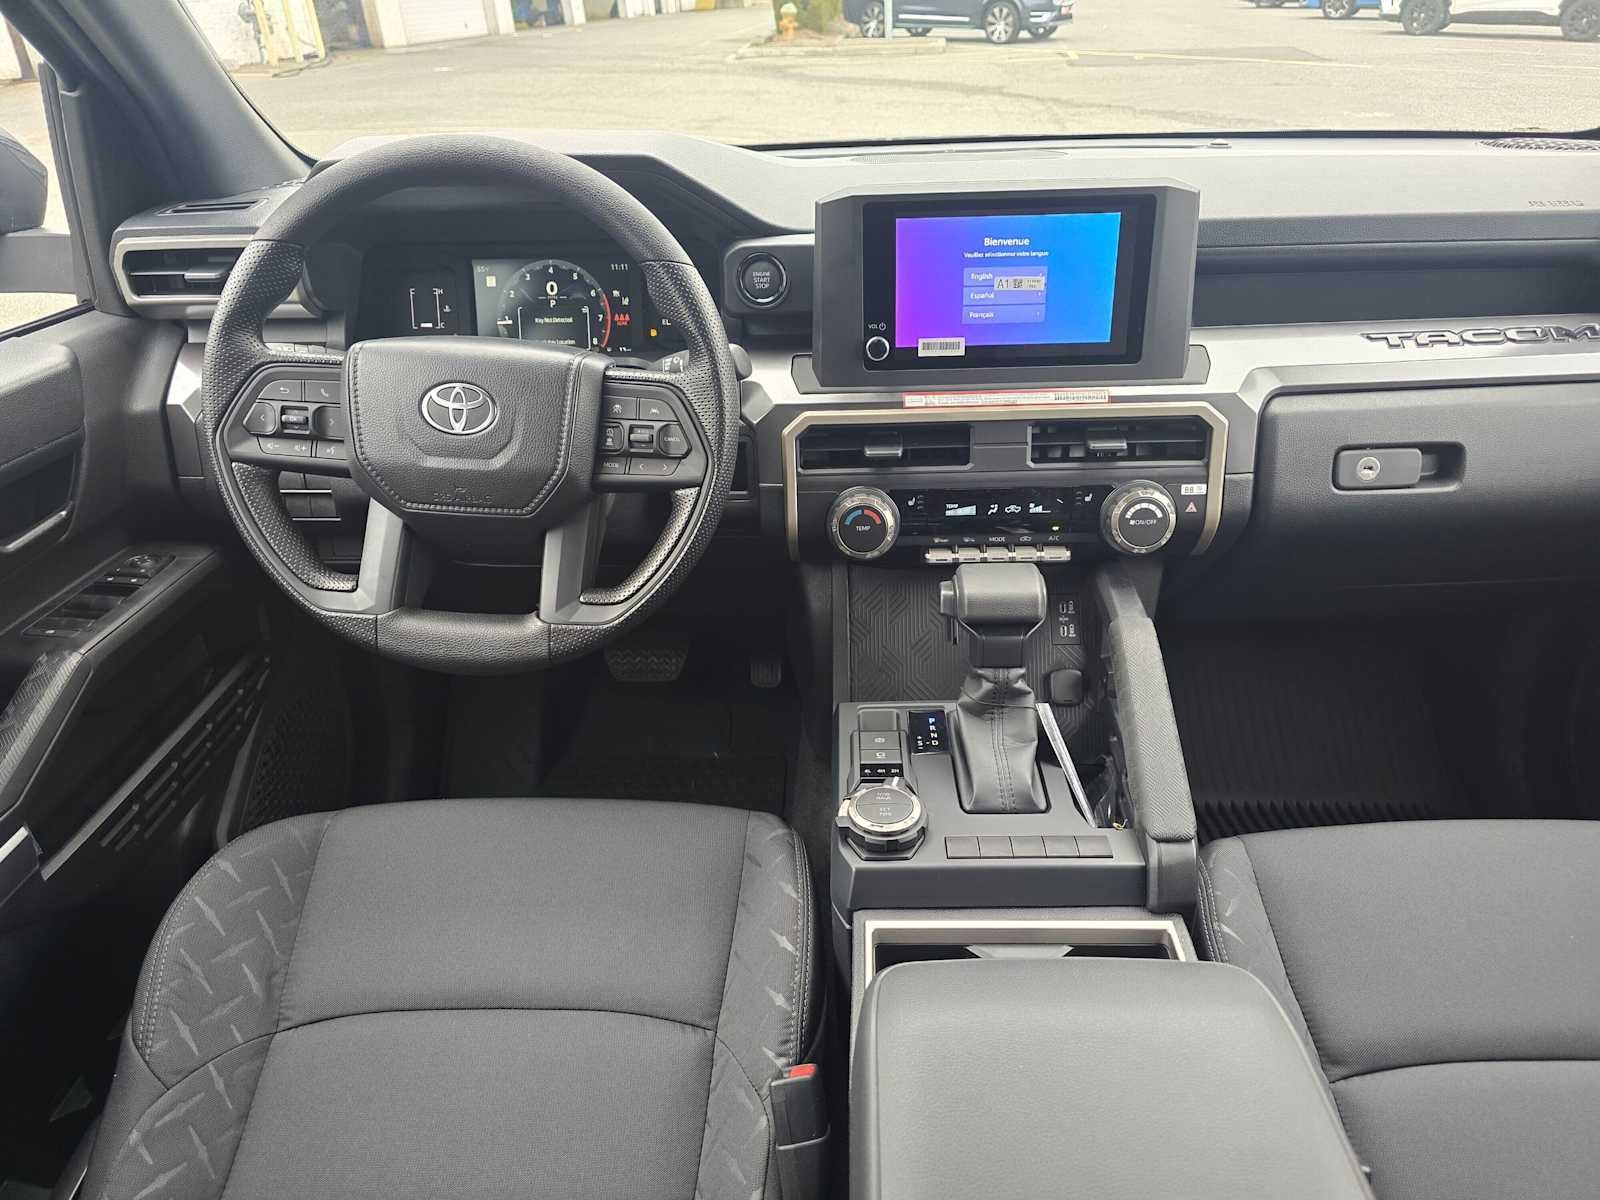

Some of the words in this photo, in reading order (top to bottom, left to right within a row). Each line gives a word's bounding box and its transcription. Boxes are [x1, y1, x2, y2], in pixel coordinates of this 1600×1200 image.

[984, 237, 1030, 246] Bienvenue
[611, 263, 629, 271] 11:11
[970, 272, 993, 281] English
[546, 281, 558, 296] 0
[997, 279, 1009, 289] A1
[550, 300, 556, 308] P
